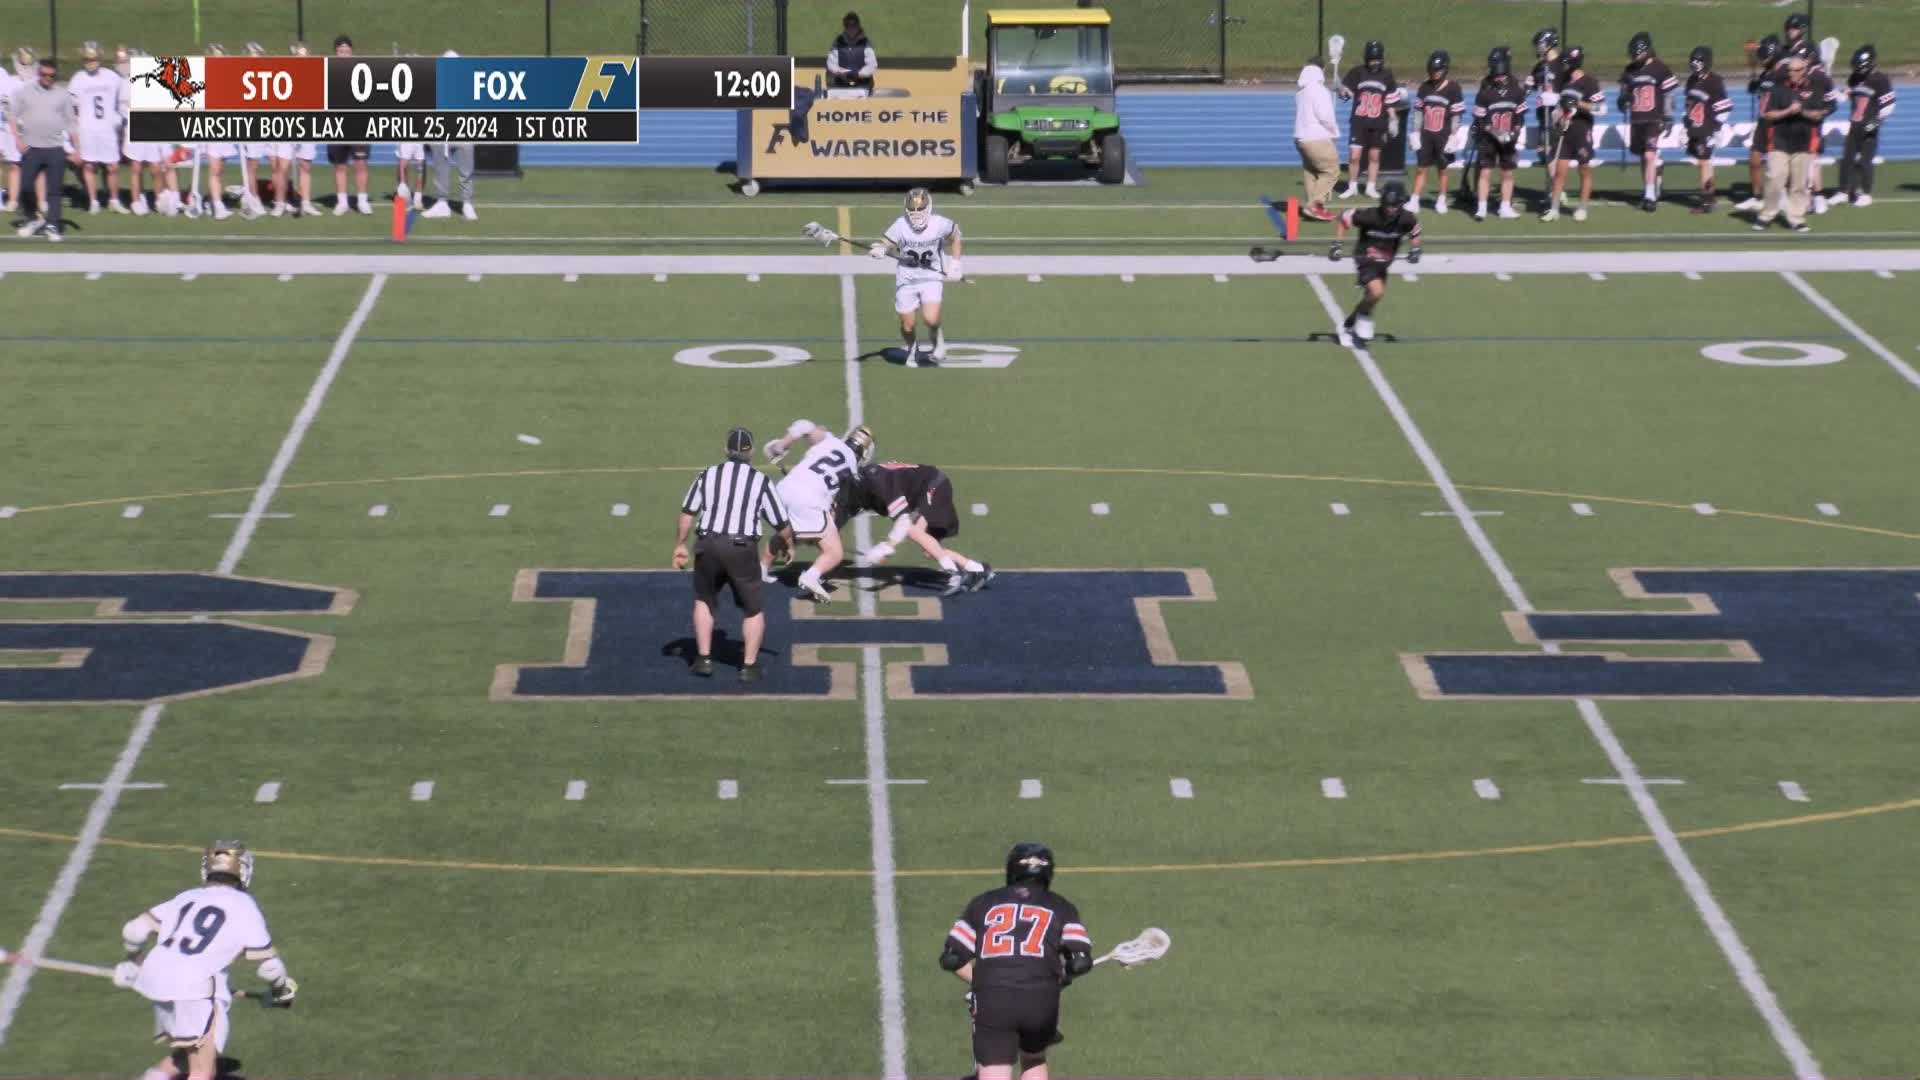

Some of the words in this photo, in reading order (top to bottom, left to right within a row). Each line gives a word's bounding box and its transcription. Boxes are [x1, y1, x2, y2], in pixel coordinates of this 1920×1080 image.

[816, 111, 872, 123] HOME
[878, 111, 903, 123] OF
[910, 111, 949, 123] THE
[810, 139, 956, 157] WARRIORS
[809, 450, 852, 490] 25
[162, 901, 226, 956] 19
[980, 903, 1054, 959] 27
